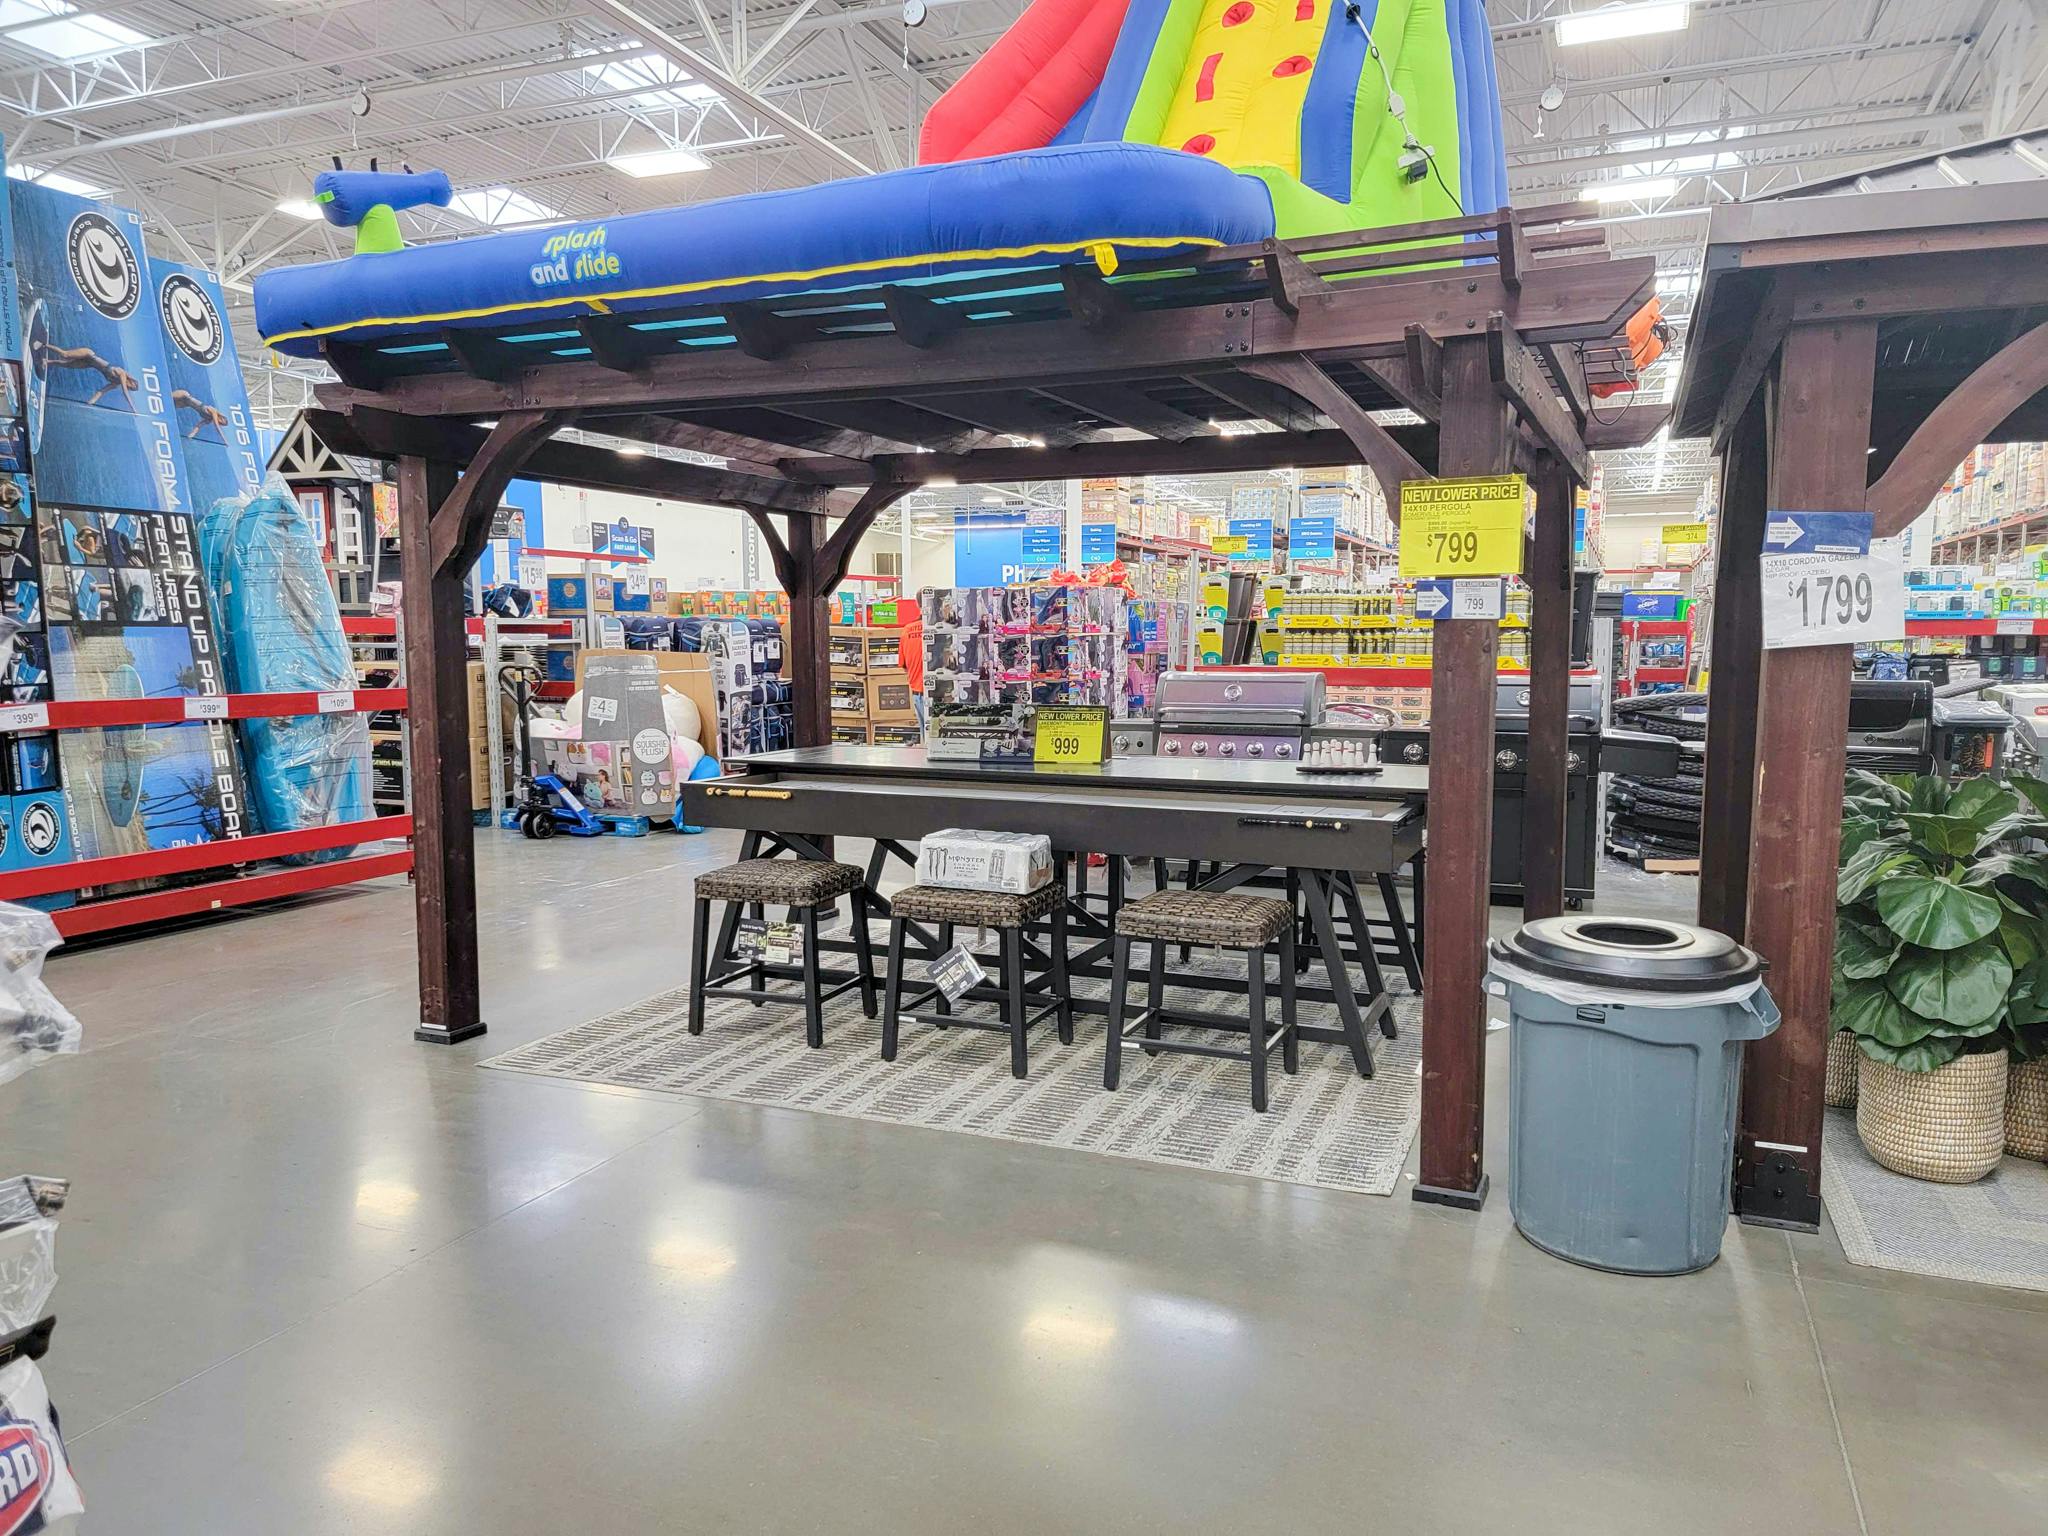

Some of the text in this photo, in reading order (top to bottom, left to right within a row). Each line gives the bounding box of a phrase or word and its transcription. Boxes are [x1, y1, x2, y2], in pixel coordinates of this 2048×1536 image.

[543, 225, 606, 258] splash
[531, 251, 620, 285] and slide
[151, 419, 182, 512] FOAM
[241, 451, 261, 497] FOA
[1404, 485, 1518, 503] NEW LOWER PRICE
[1430, 503, 1471, 511] PERGOLA
[1427, 531, 1478, 563] $799
[151, 514, 183, 624] FEATURES
[1788, 555, 1826, 567] CORDOVA
[1827, 553, 1861, 563] GAZEBO
[170, 515, 202, 610] STAND
[188, 615, 210, 654] UP
[597, 700, 607, 713] 4
[1039, 712, 1055, 720] NEW
[1081, 713, 1102, 721] PRICE
[641, 748, 664, 756] PLUSH
[1050, 737, 1079, 755] $999
